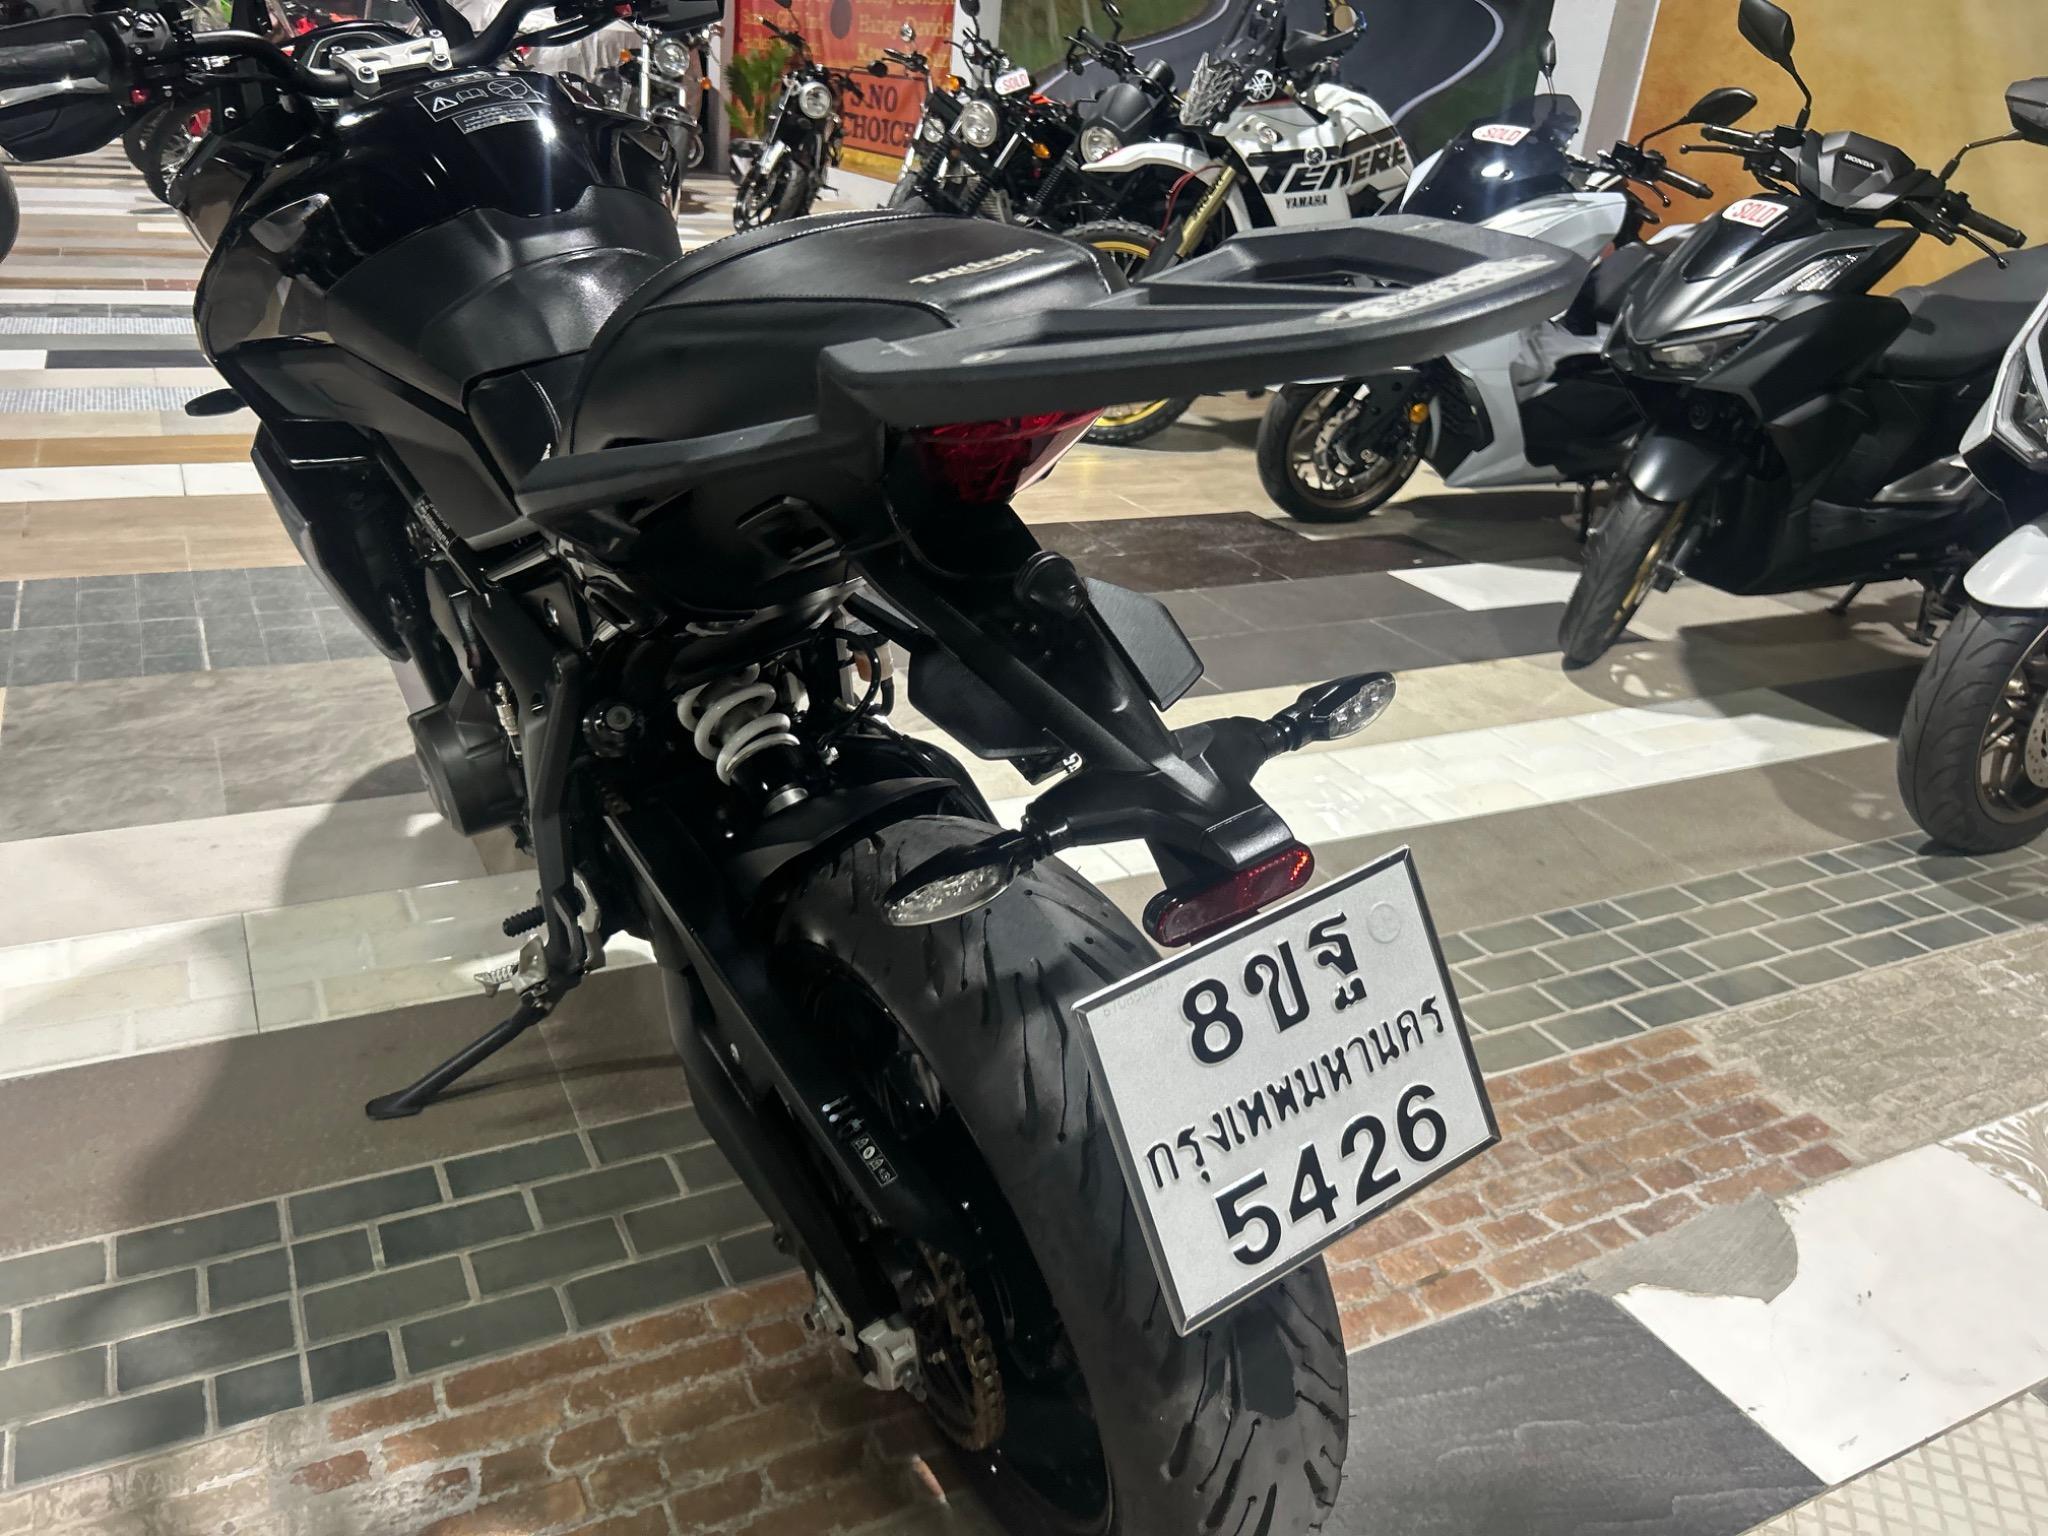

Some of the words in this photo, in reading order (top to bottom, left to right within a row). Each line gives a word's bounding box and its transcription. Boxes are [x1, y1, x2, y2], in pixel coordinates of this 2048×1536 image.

[1002, 73, 1028, 91] SOLD
[1482, 127, 1521, 142] SOLD
[1844, 153, 1875, 170] HONDA
[1285, 194, 1328, 210] YAMAHA
[1732, 202, 1778, 223] SOLD
[1182, 911, 1368, 1065] 8ขฐ
[1144, 996, 1445, 1189] กรุงเทพมหานคร
[1213, 1084, 1447, 1266] 5426
